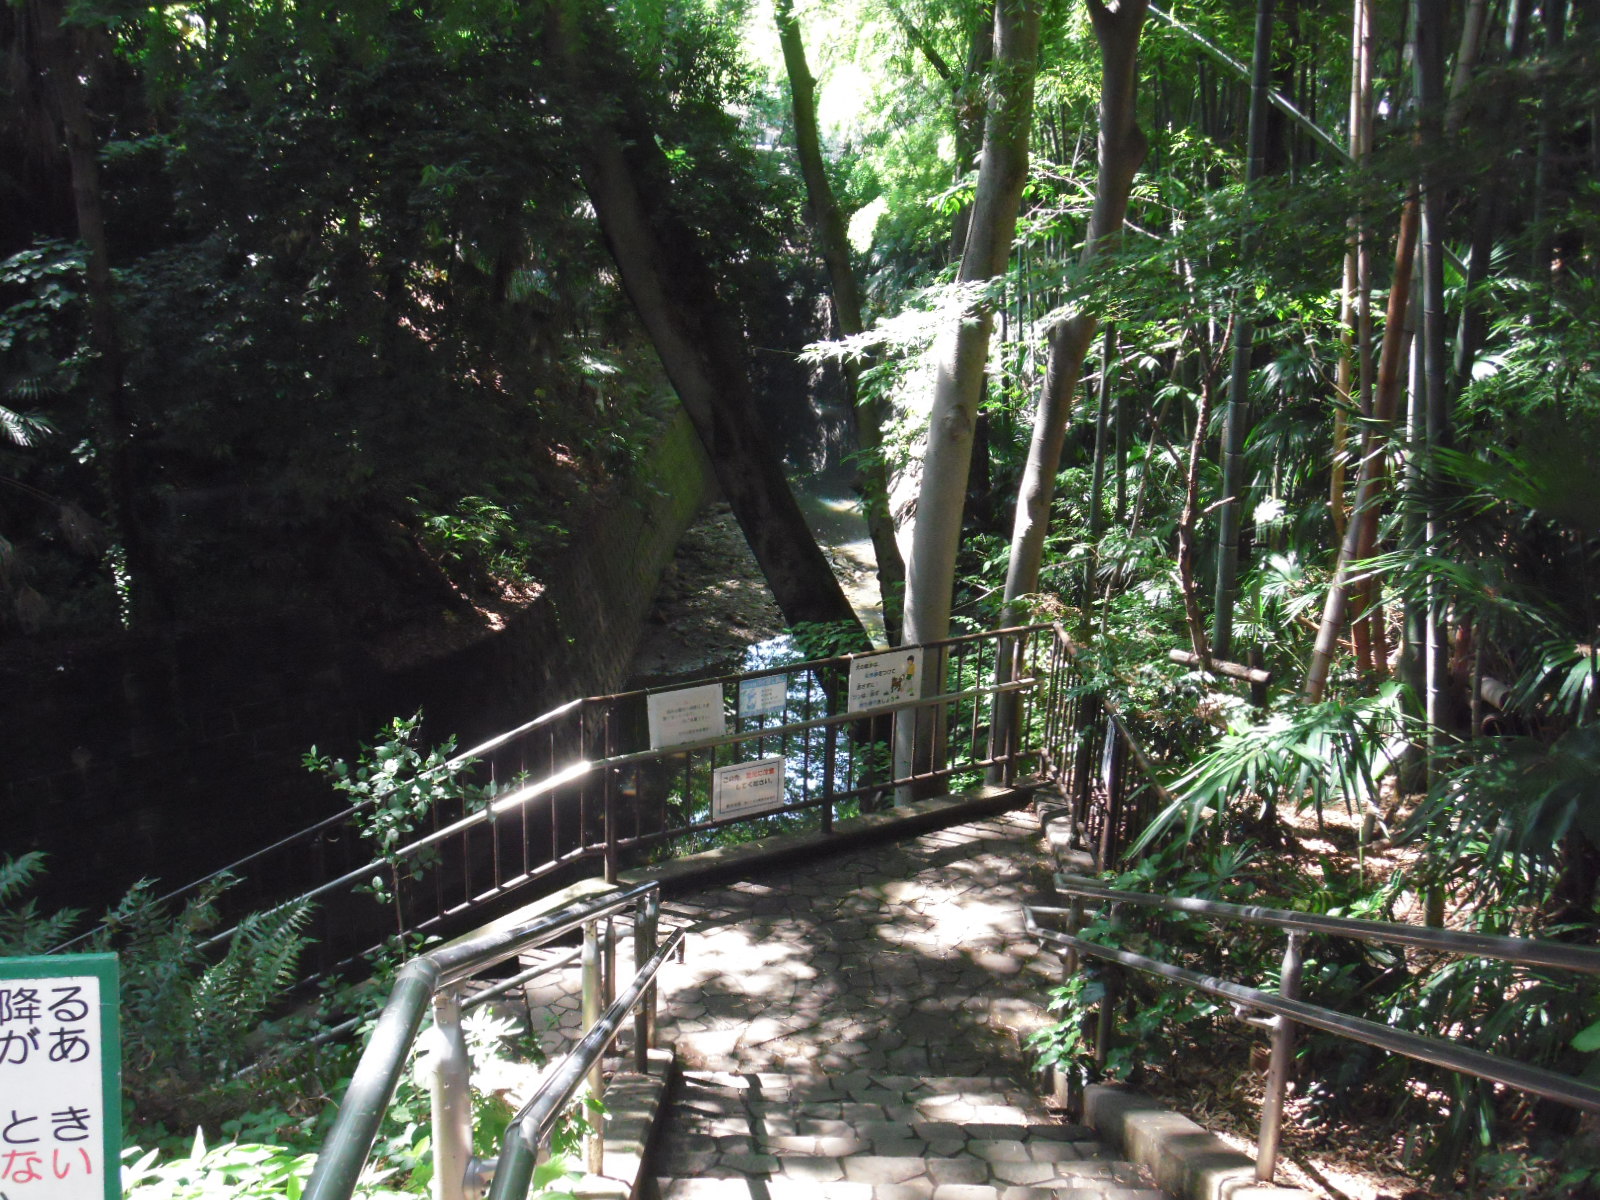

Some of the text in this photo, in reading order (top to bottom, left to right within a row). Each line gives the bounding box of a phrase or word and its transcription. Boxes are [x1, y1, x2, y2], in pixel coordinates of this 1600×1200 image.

[0, 986, 89, 1025] 降る
[0, 1026, 90, 1064] があ
[2, 1106, 91, 1144] とき
[1, 1147, 93, 1184] ない
